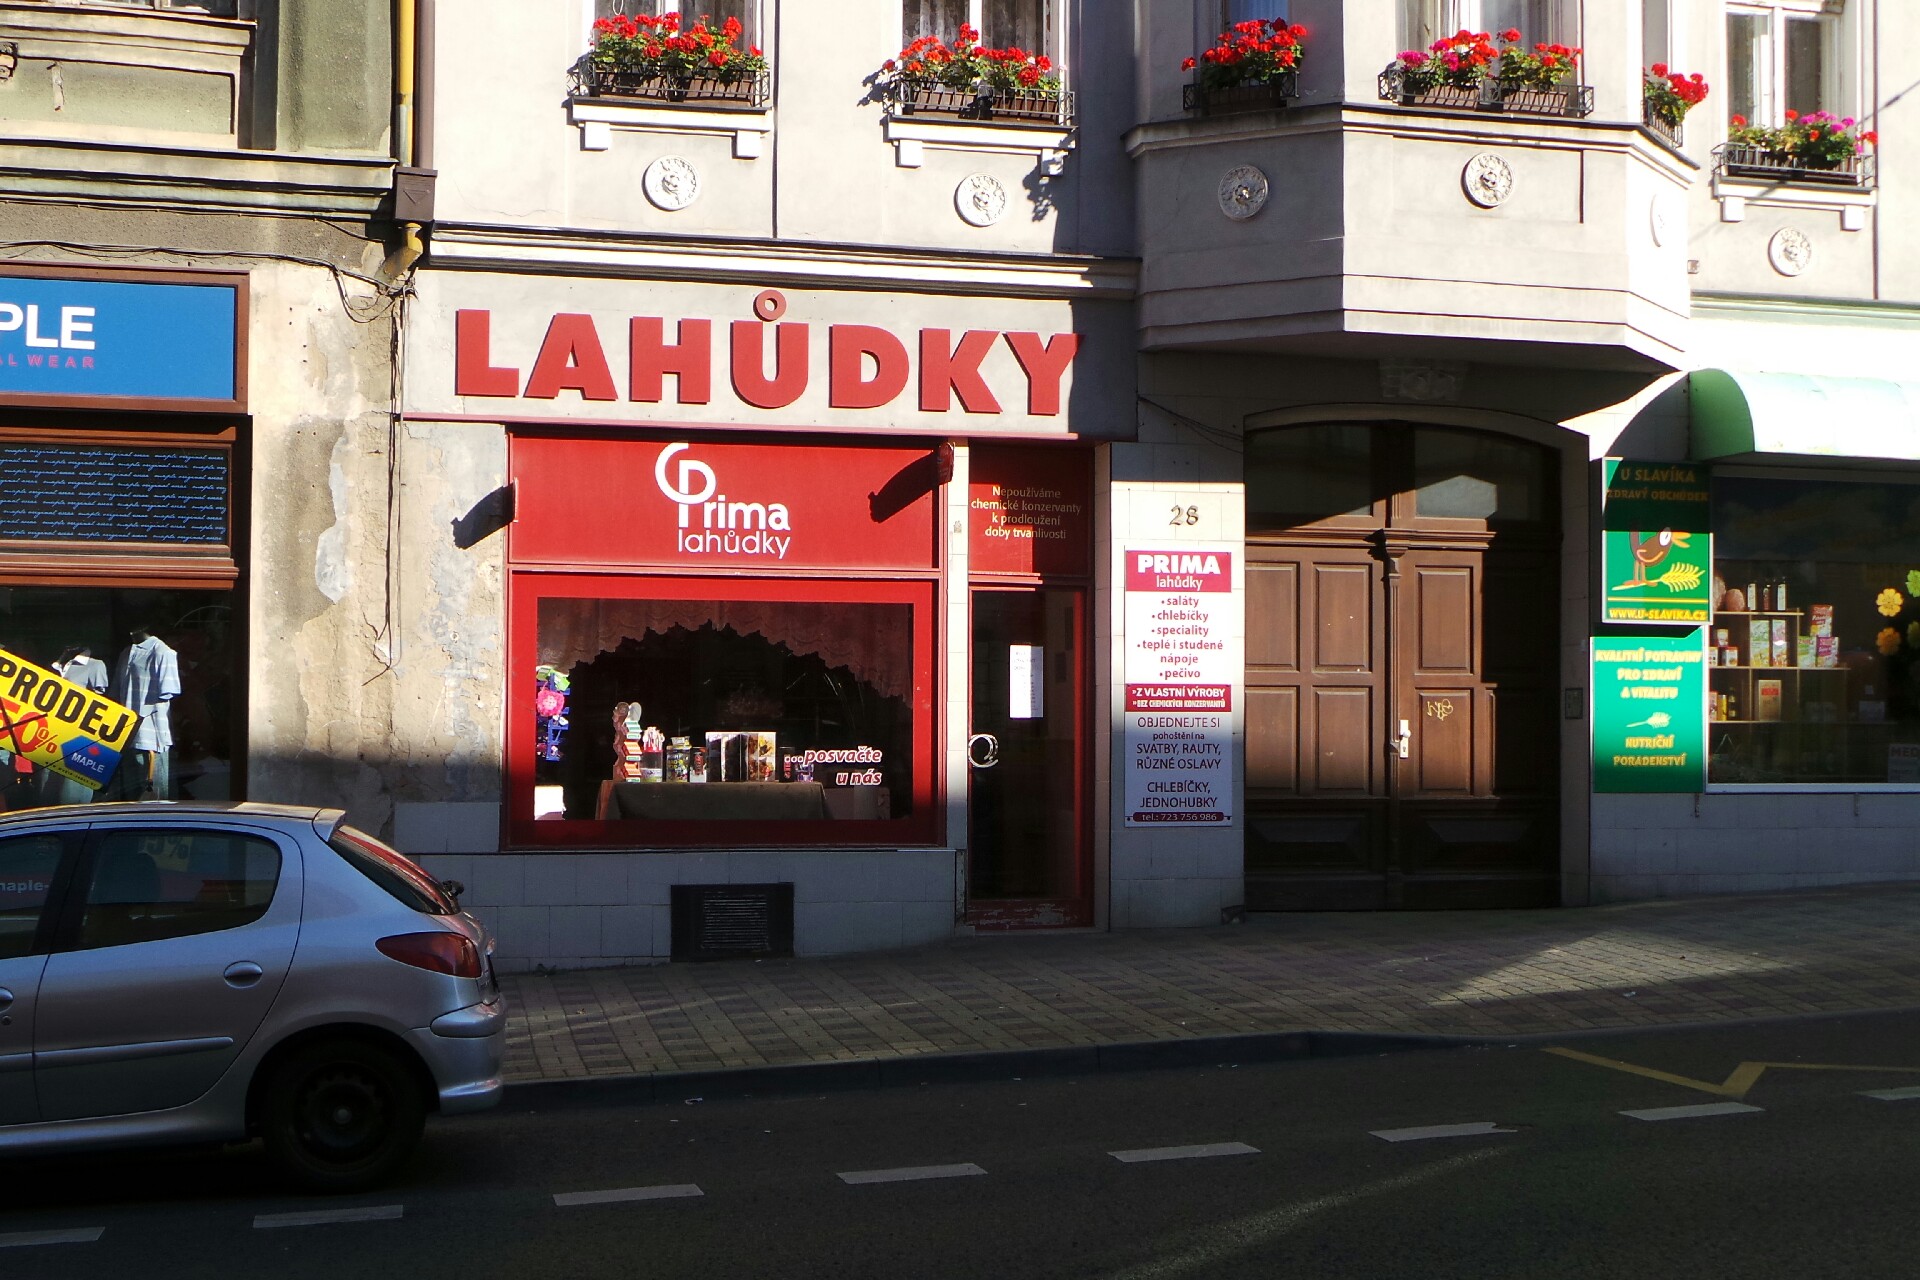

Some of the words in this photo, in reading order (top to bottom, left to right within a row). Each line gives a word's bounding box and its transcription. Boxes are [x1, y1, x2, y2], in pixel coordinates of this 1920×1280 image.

[454, 289, 1080, 416] LAHŮDKY
[0, 353, 17, 367] L
[27, 354, 94, 368] WEAR
[1620, 468, 1629, 481] U
[1635, 465, 1696, 483] SLAVÍKA
[654, 442, 791, 531] Prima
[992, 486, 1061, 499] Nepoužíváme
[971, 498, 1019, 511] chemické
[1022, 500, 1081, 516] konzervanty
[992, 512, 998, 523] k
[1001, 514, 1061, 526] prodloužení
[1169, 504, 1199, 526] 28
[985, 526, 1010, 540] doby
[1013, 527, 1066, 539] trvanlivosti
[678, 529, 791, 559] lahůdky
[1137, 554, 1221, 575] PRIMA
[1156, 575, 1203, 591] lahůdky
[1167, 596, 1199, 608] saláty
[1157, 610, 1209, 622] chlebíčky
[1156, 625, 1209, 637] speciality
[1142, 640, 1170, 651] teplé
[1179, 640, 1223, 650] studené
[1160, 653, 1198, 666] nápoje
[1165, 668, 1201, 680] pečivo
[1143, 686, 1185, 697] VLASTNÍ
[1187, 686, 1226, 697] VÝROBY
[1137, 717, 1208, 728] OBJEDNEJTE
[1210, 718, 1220, 727] SI
[1153, 731, 1194, 741] pohoštění
[1625, 734, 1675, 748] NUTRIČNÍ
[1136, 743, 1179, 755] SVATBY,
[1182, 744, 1221, 755] RAUTY,
[72, 752, 105, 773] MAPLE
[1136, 757, 1175, 769] RŮZNÉ
[1177, 758, 1221, 769] OSLAVY
[1613, 753, 1687, 767] PORADENSTVÍ
[836, 773, 848, 786] u
[850, 768, 882, 786] nás
[1147, 780, 1211, 794] CHLEBÍČKY,
[1140, 797, 1218, 808] JEDNOHUBKY
